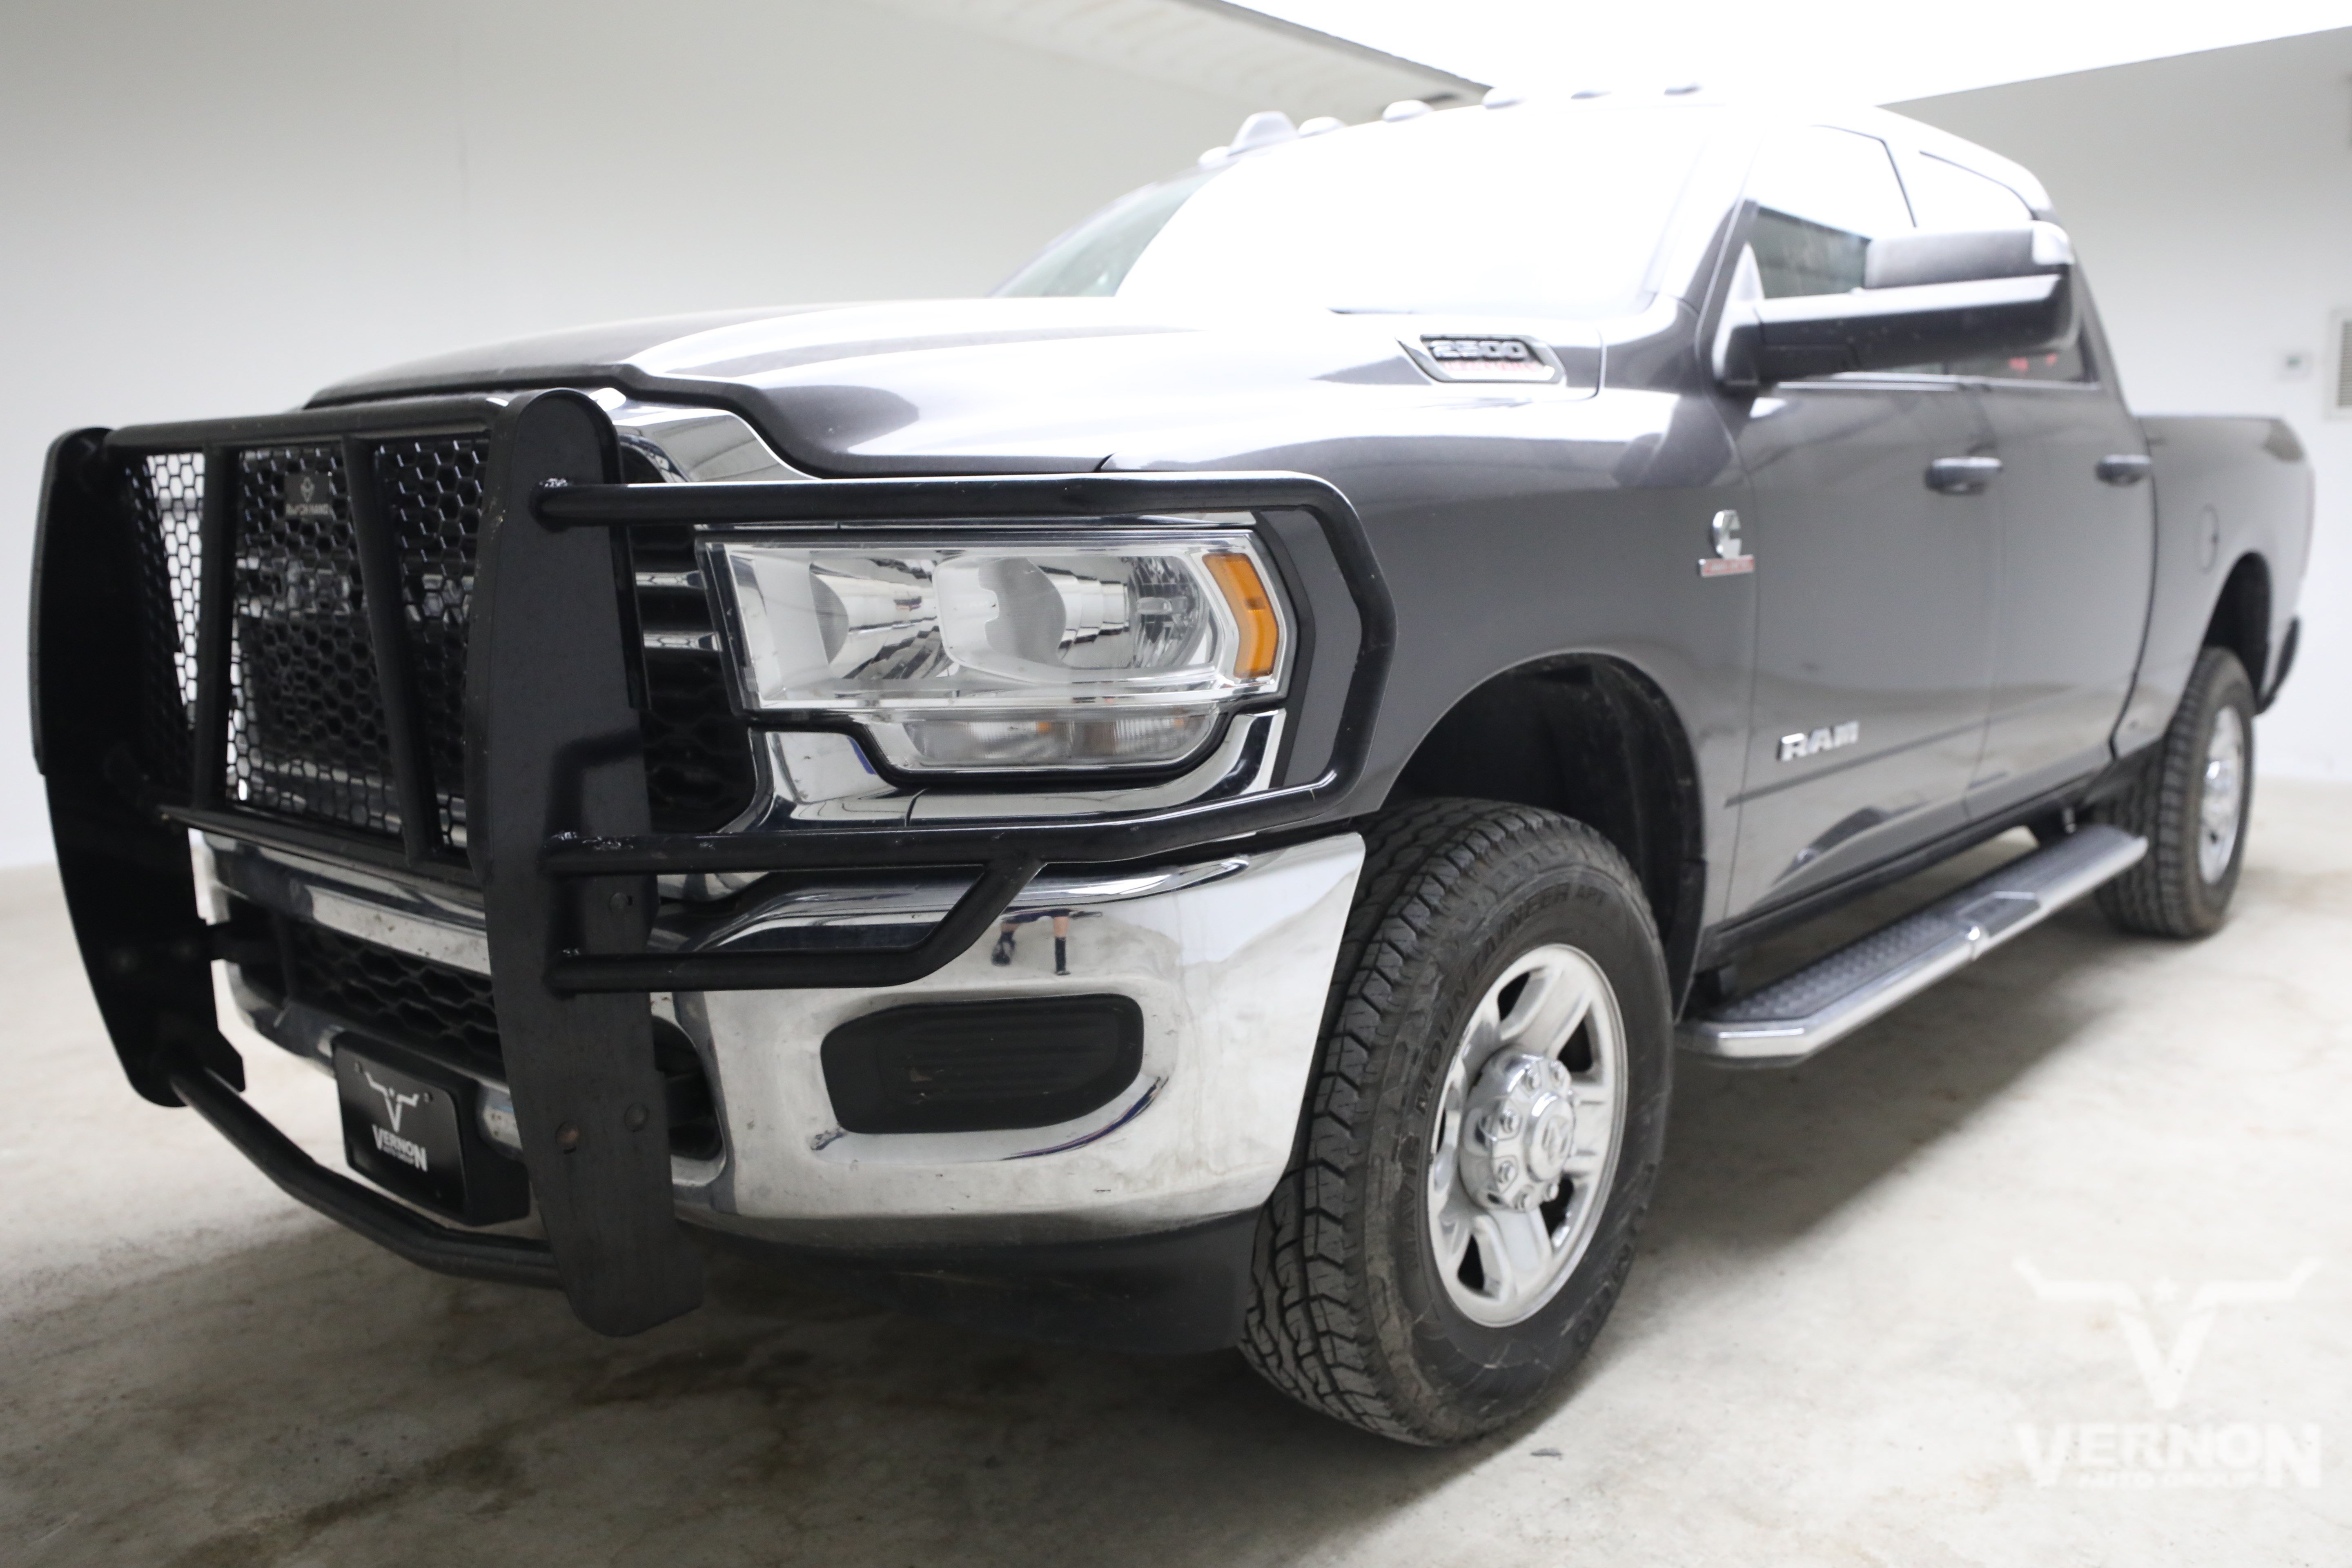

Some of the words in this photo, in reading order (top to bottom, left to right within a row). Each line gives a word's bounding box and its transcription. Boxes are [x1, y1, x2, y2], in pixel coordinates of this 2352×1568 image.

[1430, 340, 1527, 359] 2500
[1778, 721, 1859, 762] RAM
[1415, 881, 1570, 1114] MOUNTAINEER
[372, 1124, 428, 1172] VERNON
